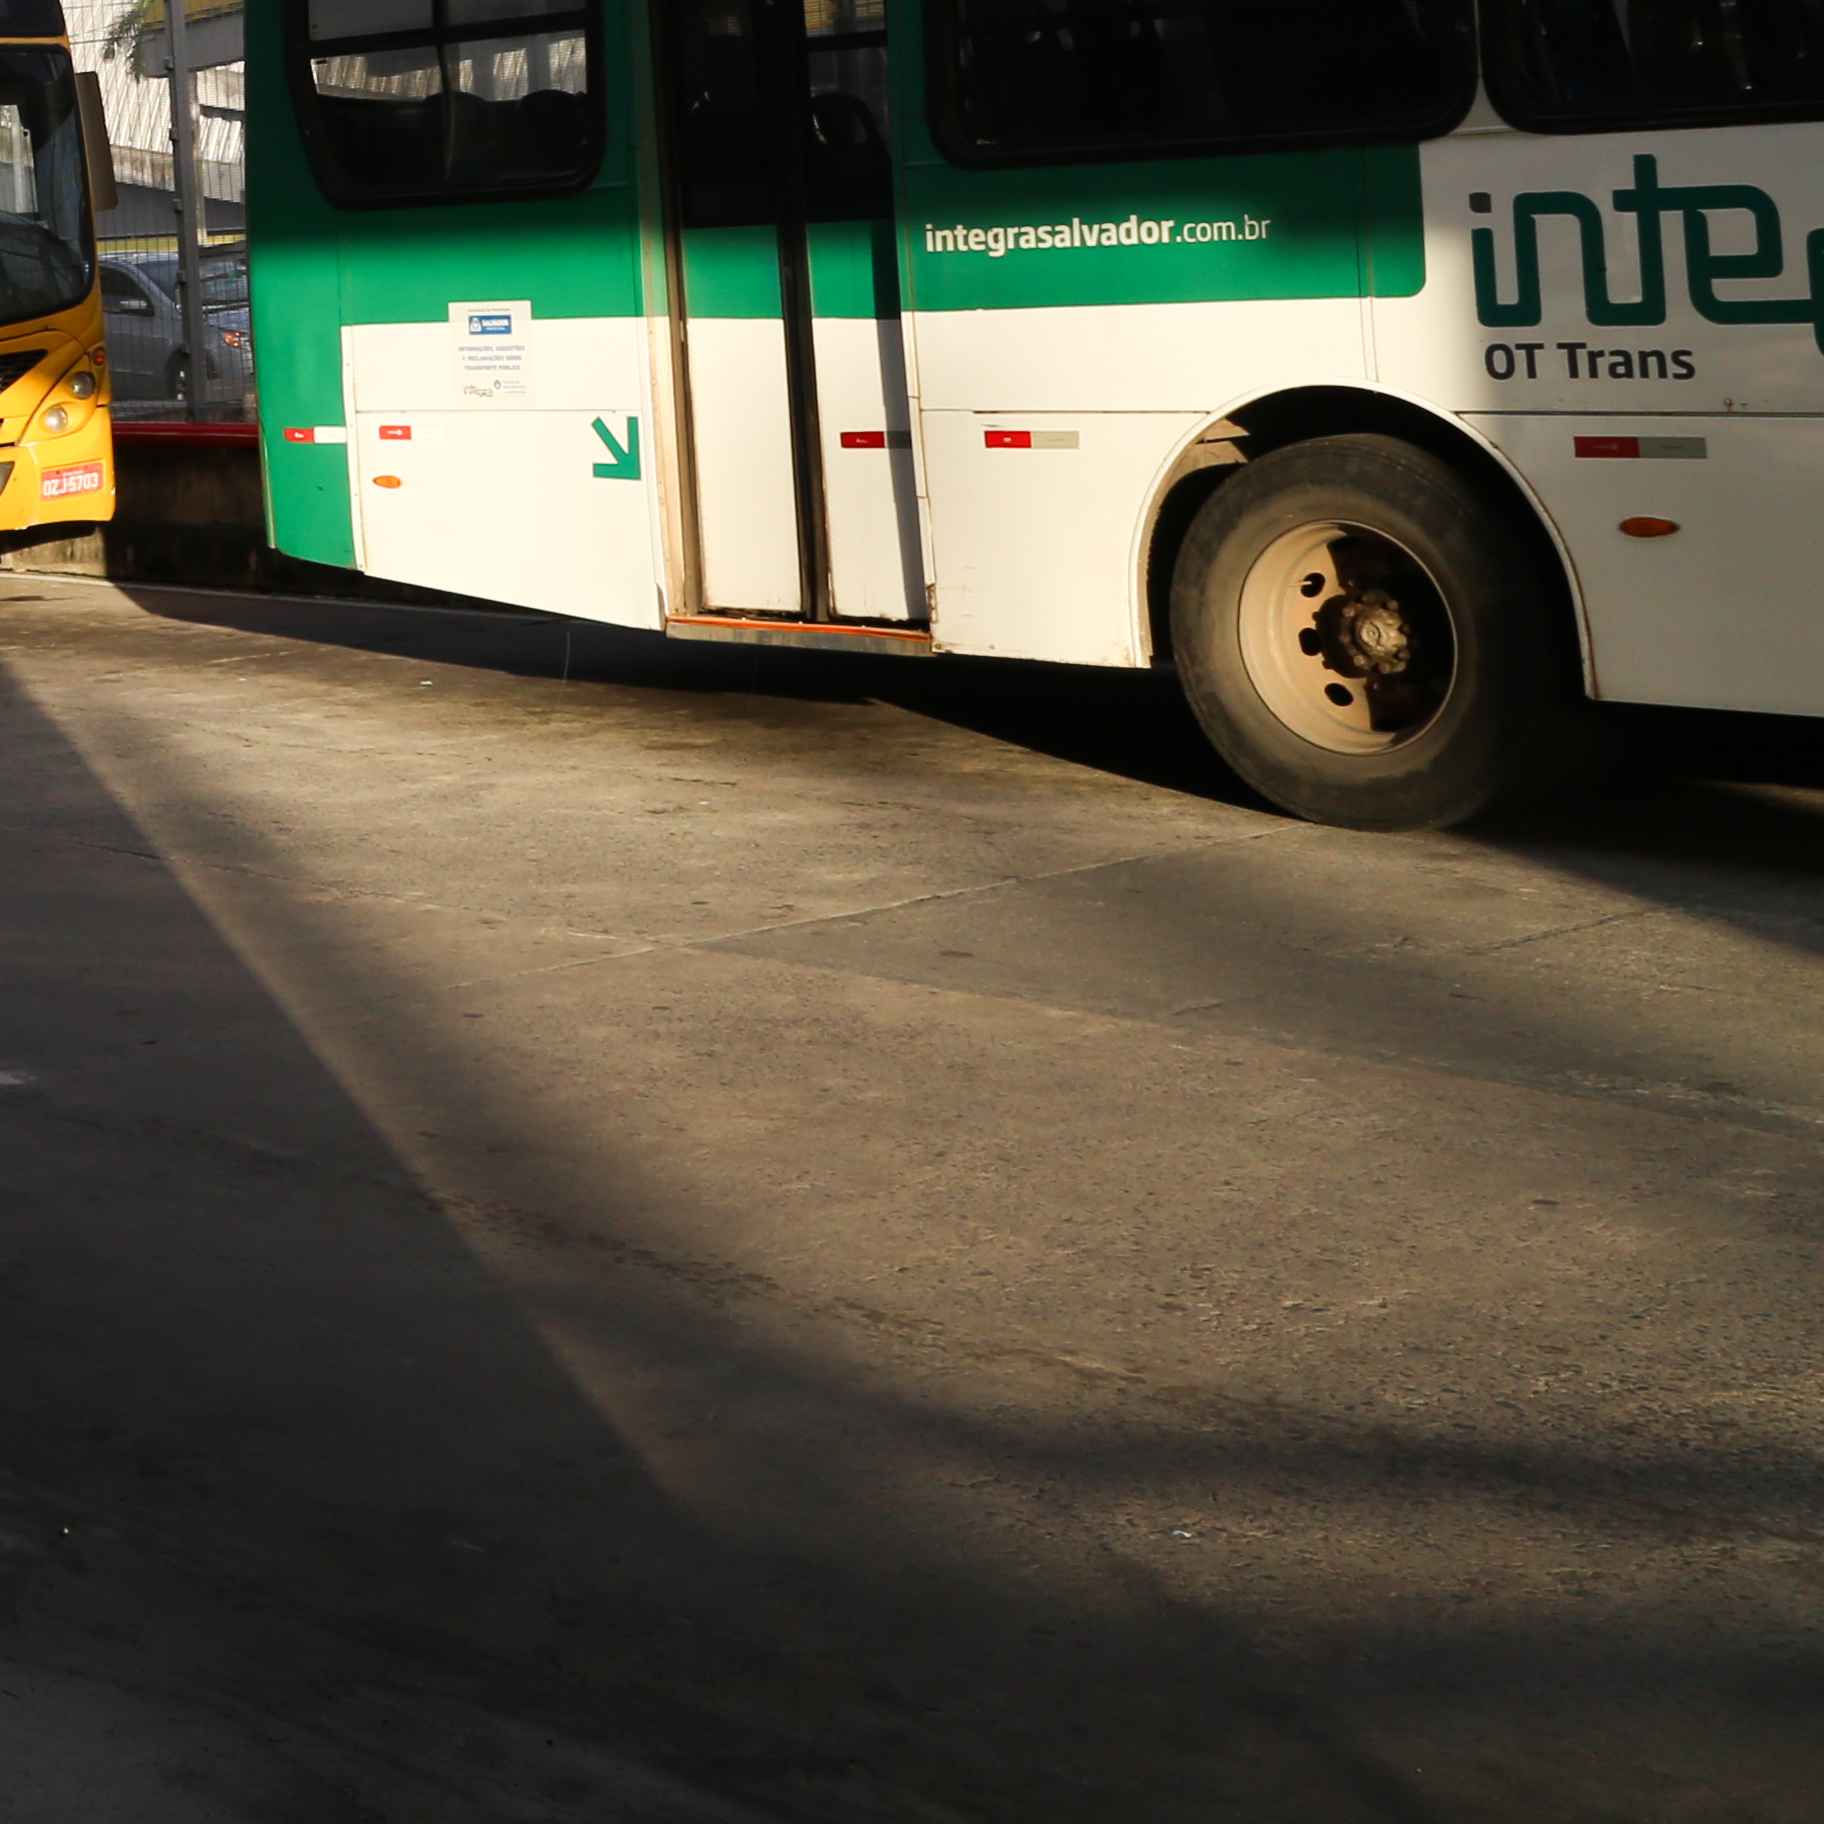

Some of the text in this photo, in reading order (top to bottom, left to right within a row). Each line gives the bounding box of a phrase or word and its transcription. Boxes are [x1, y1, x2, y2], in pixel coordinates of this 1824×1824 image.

[925, 214, 1271, 257] integrasalvador.com.br
[1468, 153, 1824, 357] inte
[1484, 342, 1696, 380] OT Trans
